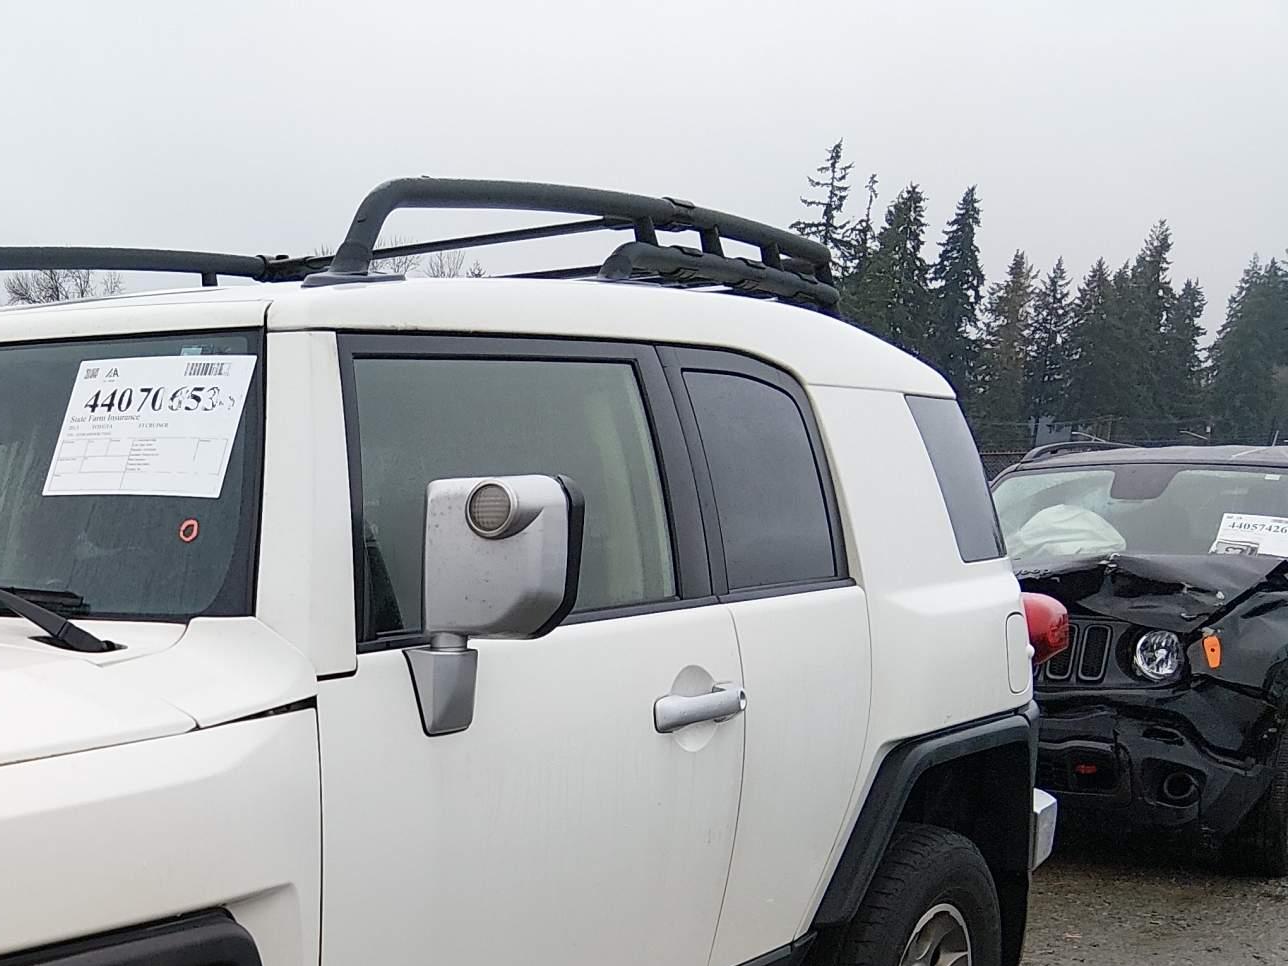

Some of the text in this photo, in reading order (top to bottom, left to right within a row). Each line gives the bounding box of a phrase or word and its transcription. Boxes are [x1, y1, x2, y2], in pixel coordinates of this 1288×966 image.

[84, 386, 220, 413] 44070653
[70, 414, 141, 424] State Farm Insurance
[1228, 521, 1288, 534] 44057426
